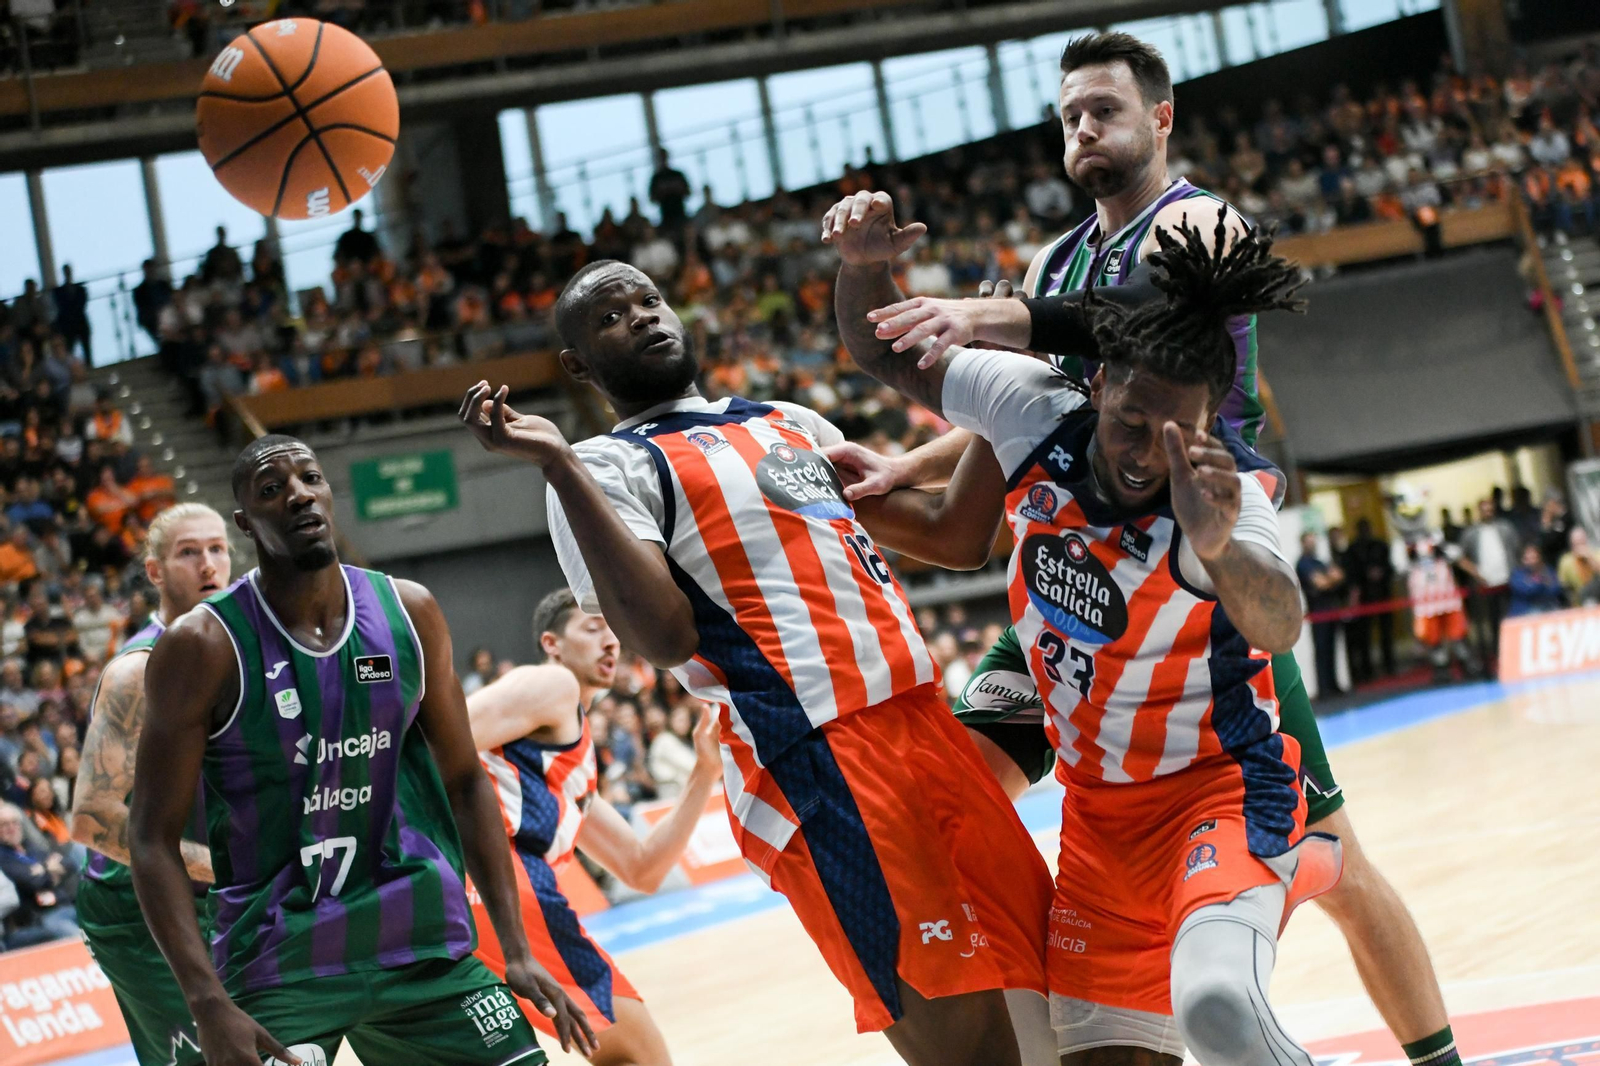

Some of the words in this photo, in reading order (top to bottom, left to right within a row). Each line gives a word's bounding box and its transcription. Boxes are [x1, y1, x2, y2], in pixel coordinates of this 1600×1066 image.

[767, 461, 832, 487] Estrella
[843, 533, 892, 585] 12
[1035, 545, 1111, 607] Estrella
[1035, 569, 1104, 627] Galicia
[358, 664, 373, 674] liga
[359, 670, 390, 680] endesa
[1037, 630, 1096, 703] 33
[967, 672, 1042, 706] famade
[316, 726, 391, 764] Uncaja
[300, 836, 357, 903] 77
[919, 919, 954, 945] PG
[1060, 916, 1092, 929] GALICIA
[1046, 929, 1087, 953] alicia
[0, 963, 110, 1013] agamo
[461, 992, 482, 1008] sabor
[473, 986, 512, 1018] má
[2, 1000, 104, 1048] lenda
[472, 1006, 520, 1037] laga
